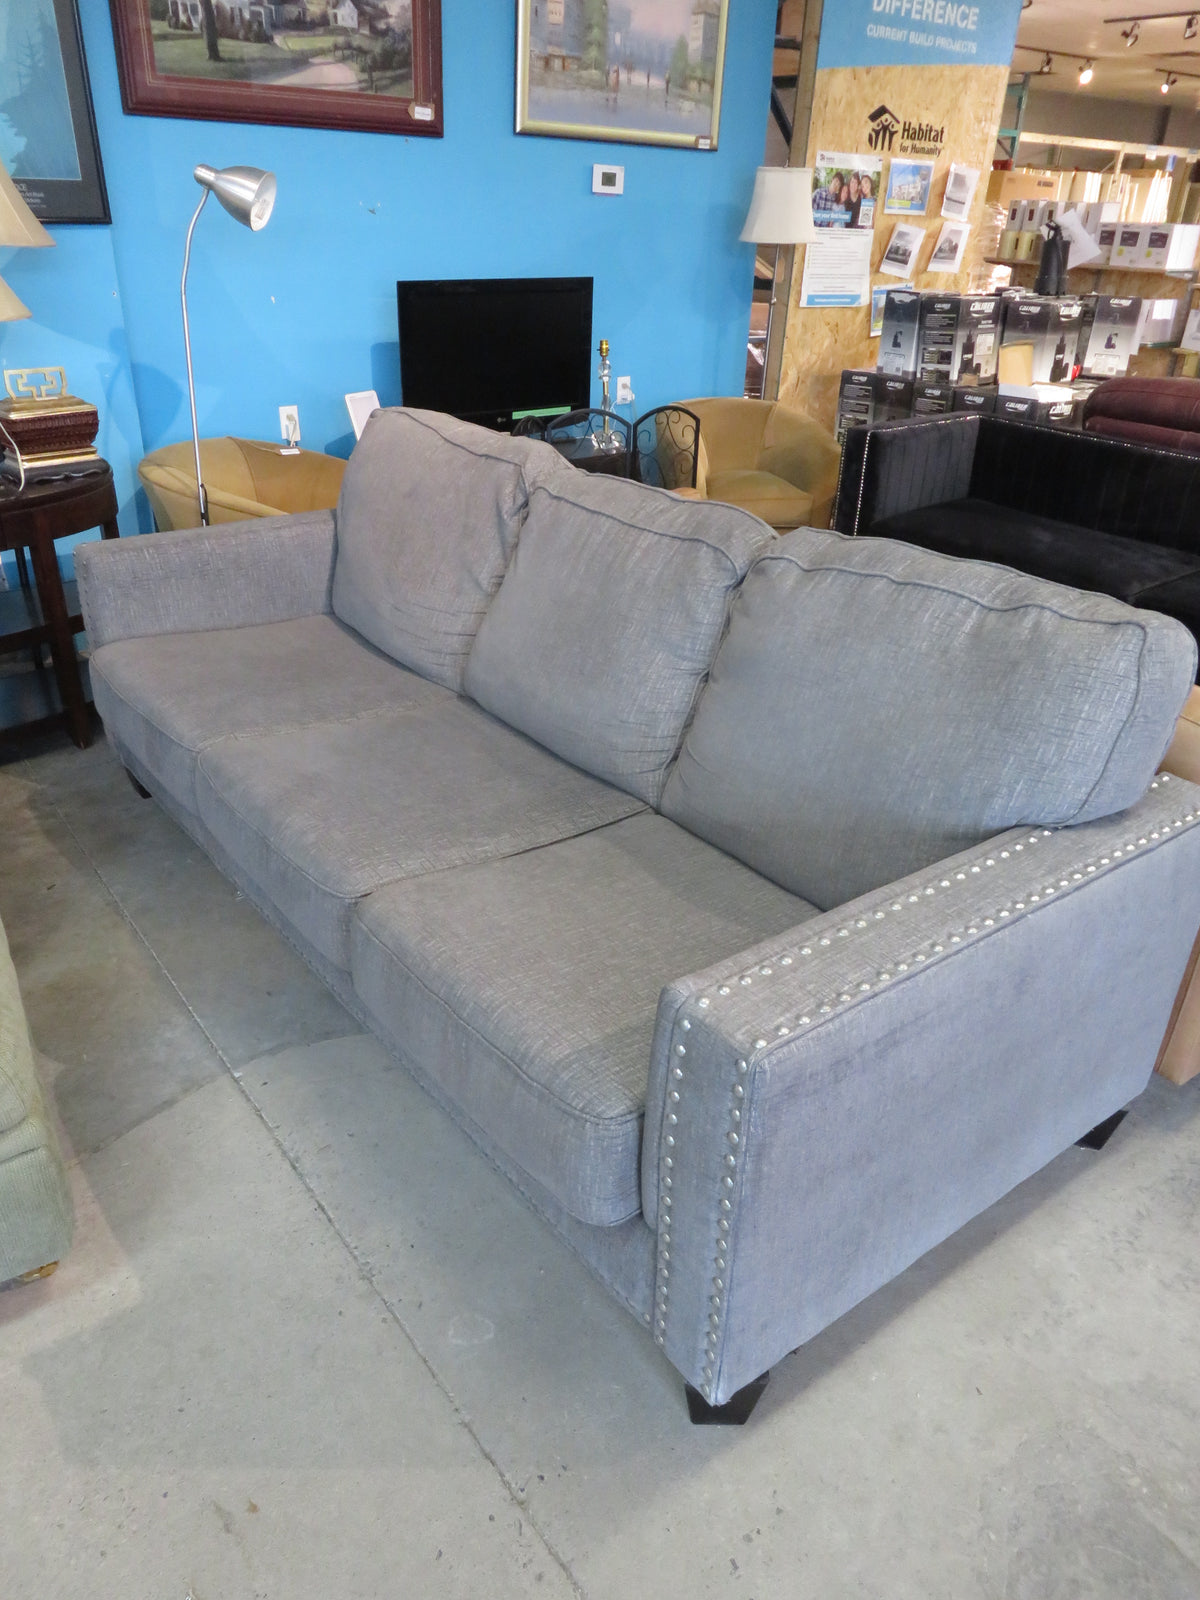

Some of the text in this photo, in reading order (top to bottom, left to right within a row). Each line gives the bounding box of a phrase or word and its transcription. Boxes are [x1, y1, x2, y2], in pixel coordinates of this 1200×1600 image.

[872, 0, 980, 30] DIFFERENCE
[866, 24, 977, 54] CURRENT BUILD PROJECTS
[901, 121, 945, 143] Habitat
[899, 143, 942, 158] for Humanity
[970, 301, 995, 311] CALIBER
[1005, 402, 1029, 411] CALIBER
